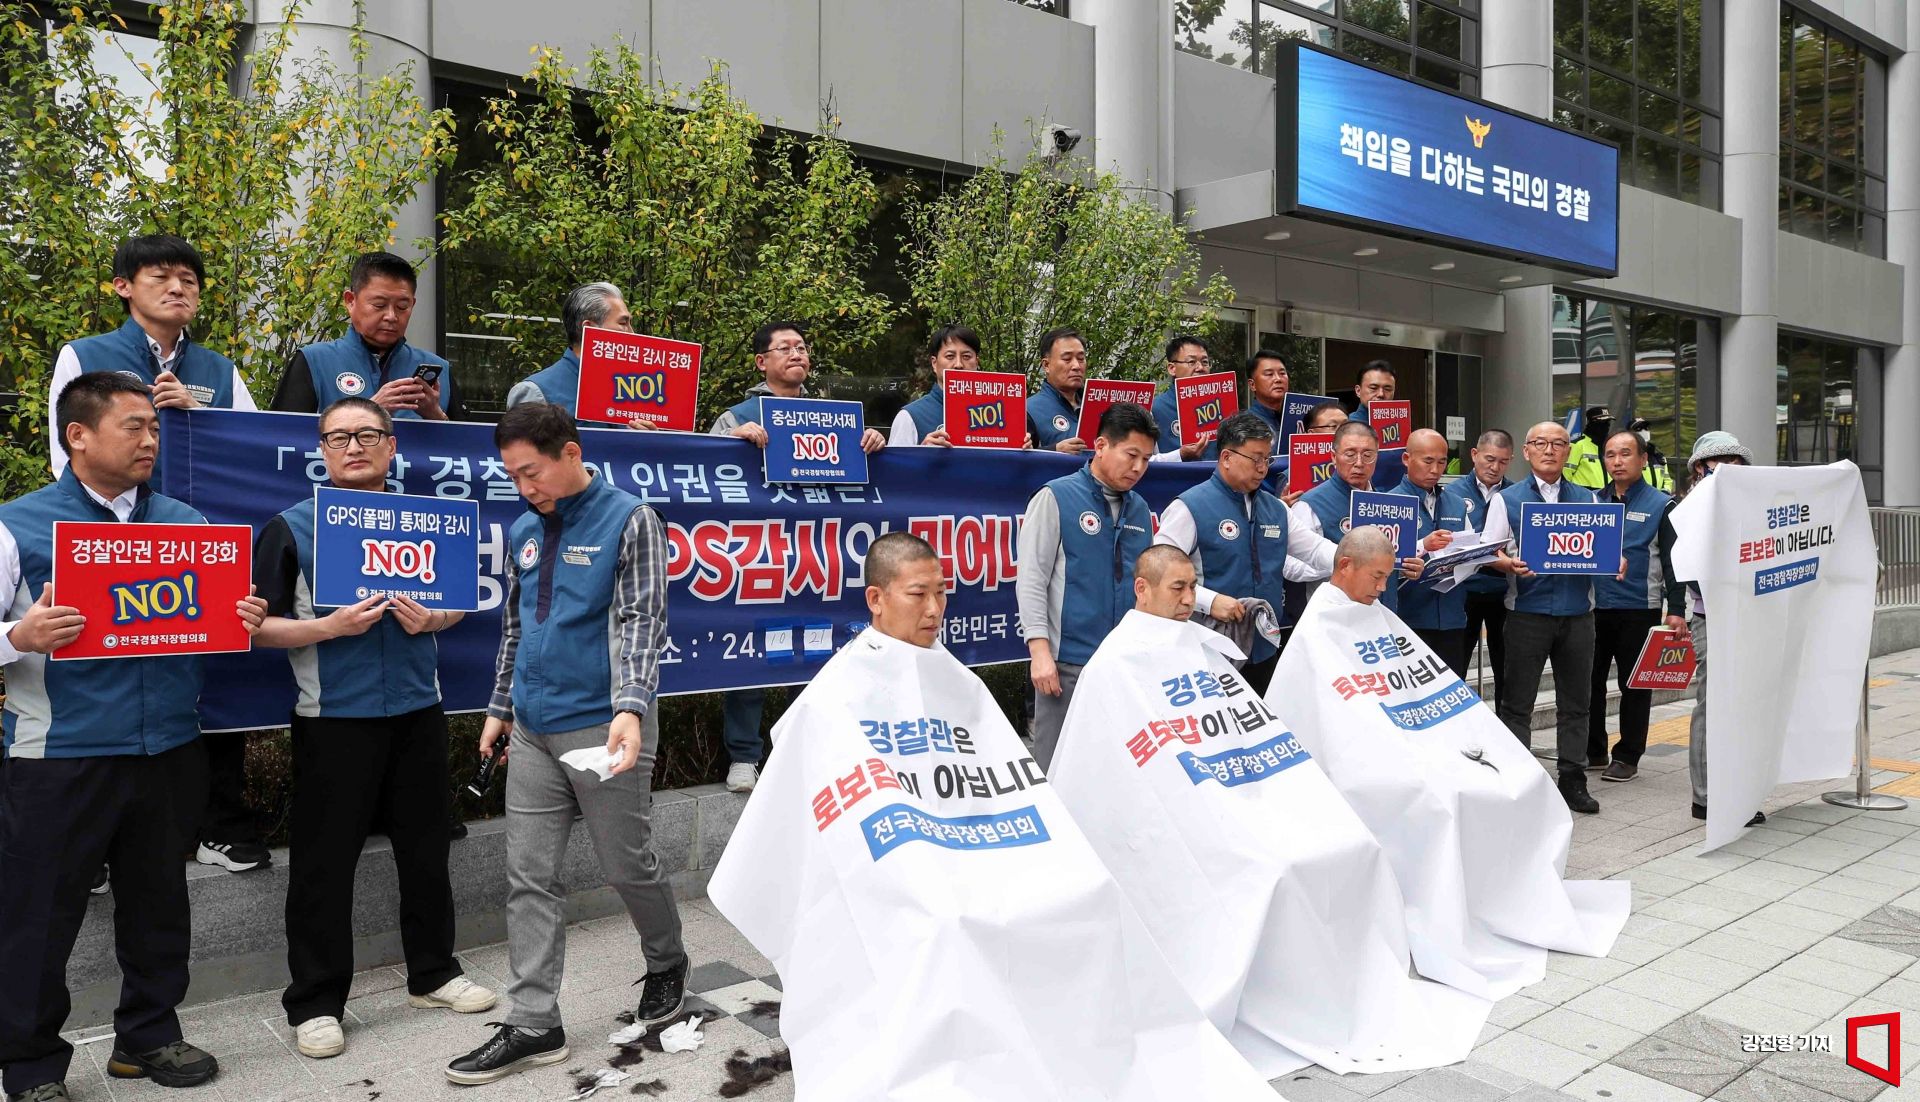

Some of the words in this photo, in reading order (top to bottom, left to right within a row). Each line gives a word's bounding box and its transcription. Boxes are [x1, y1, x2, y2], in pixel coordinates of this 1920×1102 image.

[1340, 122, 1411, 177] 책임을
[1421, 146, 1485, 195] 다하는
[1492, 165, 1548, 212] 국민의
[1555, 182, 1591, 222] 경찰
[592, 340, 640, 363] 경찰인권
[642, 348, 666, 366] 감시
[668, 351, 692, 370] 강화
[614, 373, 664, 403] NO!
[948, 379, 973, 396] 군대식
[974, 381, 1005, 396] 밀어내기
[1006, 383, 1023, 398] 순찰
[1087, 388, 1109, 402] 군대식
[1109, 389, 1136, 403] 밀어내기
[1137, 390, 1152, 405] 순찰
[1179, 386, 1198, 400] 군대식
[1198, 383, 1221, 397] 밀어내기
[1222, 380, 1234, 393] 순찰
[771, 410, 857, 429] 중심지역관서제
[968, 402, 1004, 428] NO!
[1196, 399, 1223, 425] NO!
[1390, 407, 1399, 419] 감시
[1399, 407, 1408, 419] 강화
[1382, 423, 1400, 443] NO!
[793, 433, 839, 464] NO!
[1293, 442, 1317, 455] 군대식
[631, 463, 750, 503] 인권을
[326, 505, 396, 531] GPS(폴맵)
[400, 511, 441, 534] 통제와
[444, 515, 471, 536] 감시
[1358, 502, 1414, 521] 중심지역관서제
[1531, 513, 1616, 528] 중심지역관서제
[1767, 503, 1810, 529] 경찰관은
[71, 539, 152, 564] 경찰인권
[157, 541, 195, 564] 감시
[200, 541, 239, 565] 강화
[1549, 532, 1593, 557] NO!
[1739, 537, 1785, 563] 로보캅이
[1787, 524, 1835, 553] 아닙니다.
[362, 540, 435, 583] NO!
[1758, 562, 1817, 589] 전국경찰직장협의회
[113, 574, 198, 621] NO!
[119, 633, 208, 647] 전국경찰직장협의회
[1657, 648, 1687, 667] NO!
[859, 718, 976, 756] 경찰관은
[811, 758, 923, 833] 로보캅이
[871, 811, 1039, 844] 전국경찰직장협의회
